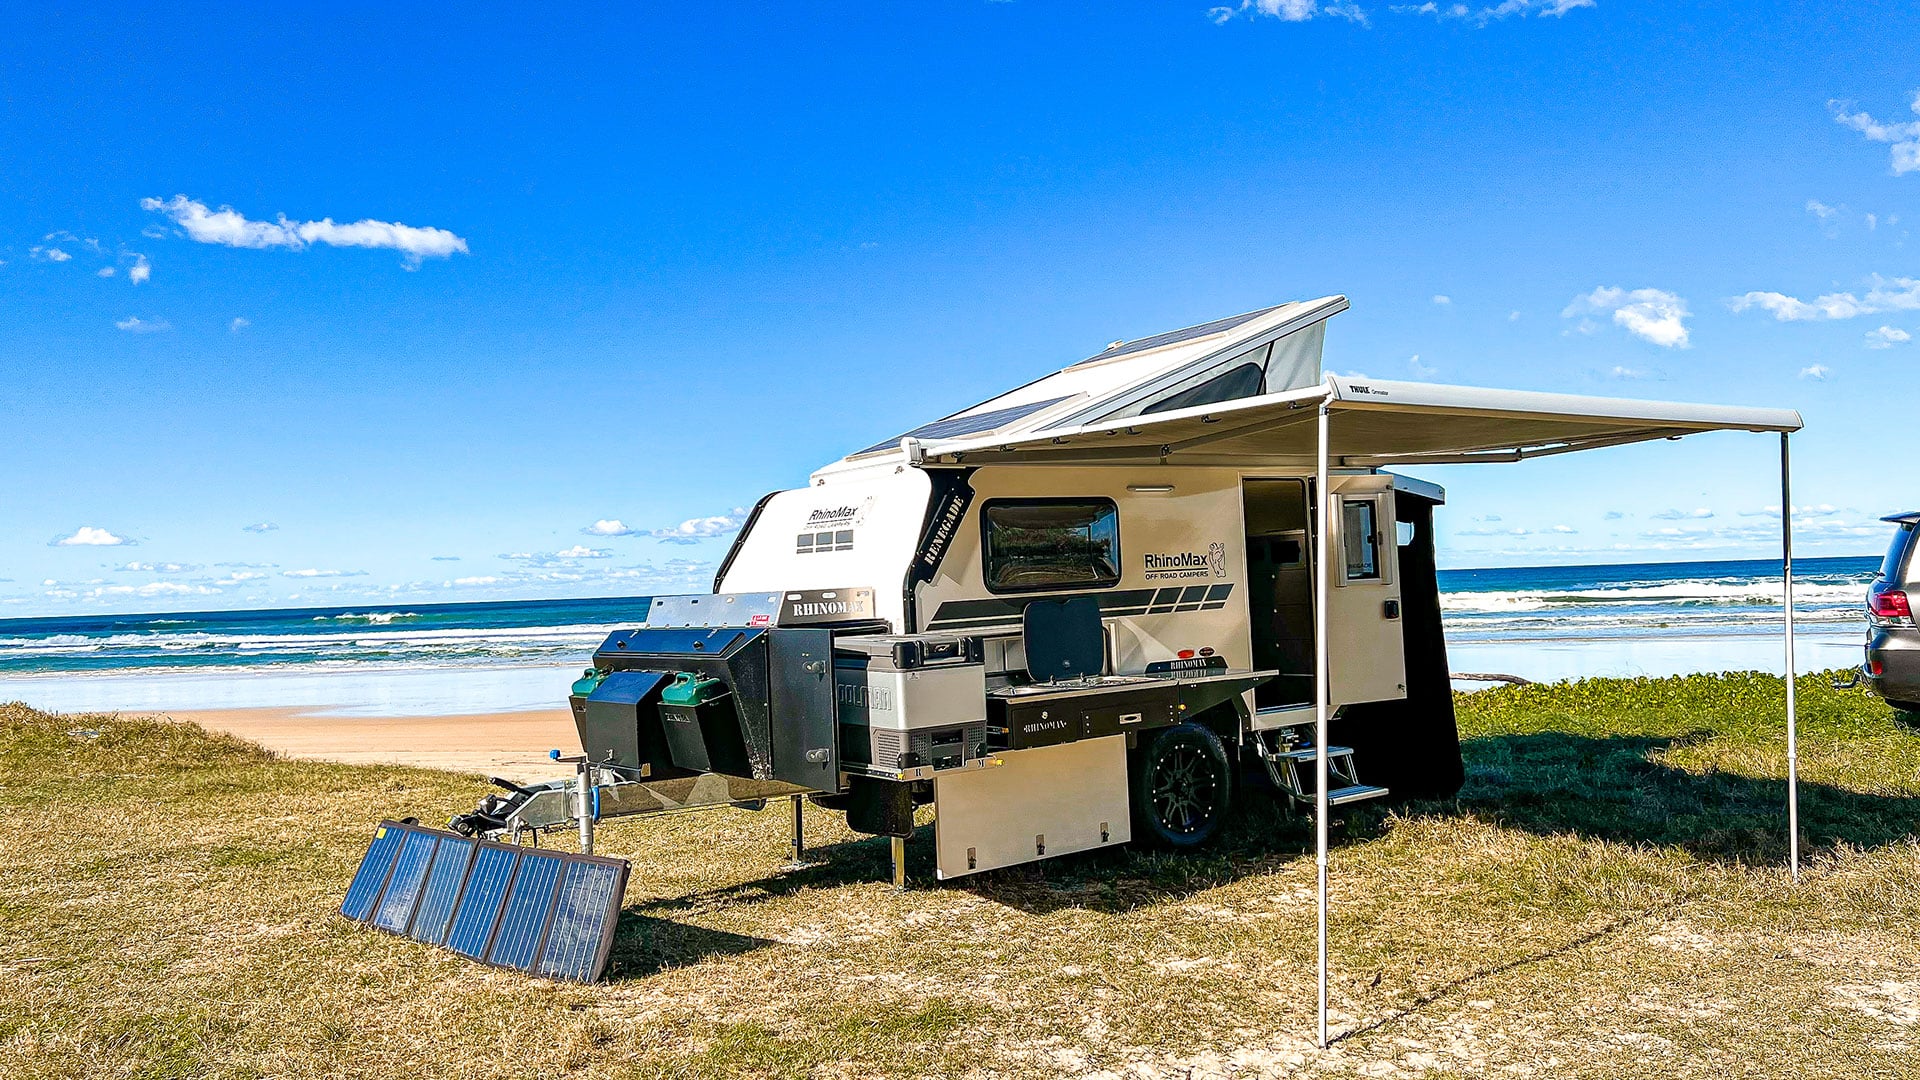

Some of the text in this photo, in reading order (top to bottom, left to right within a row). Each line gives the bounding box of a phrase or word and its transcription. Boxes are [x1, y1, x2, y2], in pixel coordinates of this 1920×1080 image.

[1349, 385, 1370, 394] THULE
[809, 505, 859, 521] RhinoMax
[924, 495, 964, 566] RENEGADE
[1144, 553, 1208, 569] RhinoMax
[1145, 570, 1209, 581] OFF ROAD CAMPERS
[793, 600, 865, 617] RHINOMAX
[1170, 658, 1207, 670] RHINOMAX
